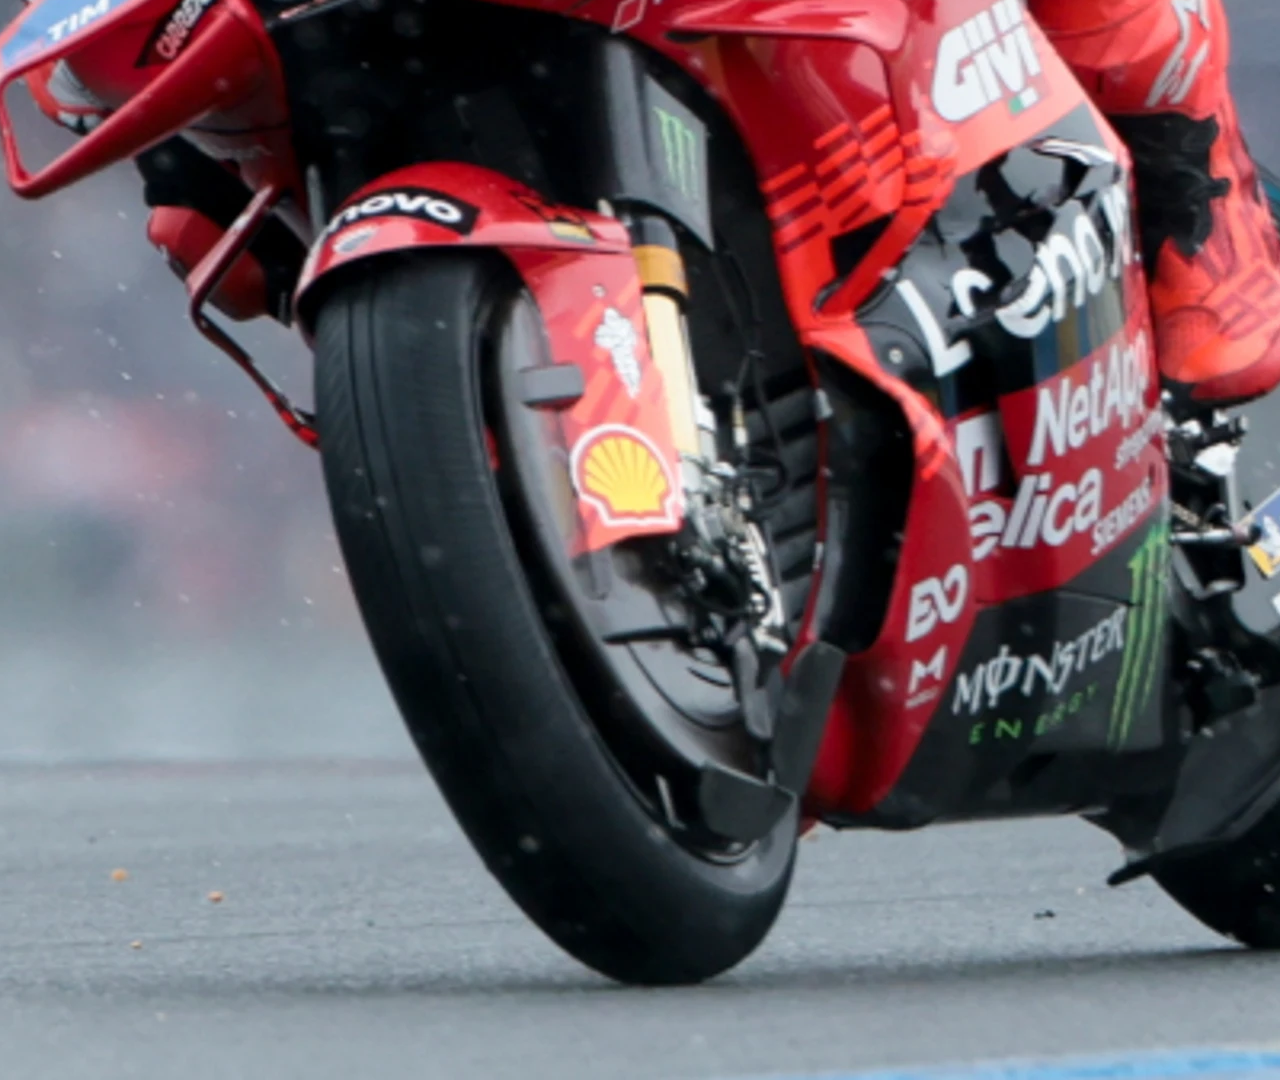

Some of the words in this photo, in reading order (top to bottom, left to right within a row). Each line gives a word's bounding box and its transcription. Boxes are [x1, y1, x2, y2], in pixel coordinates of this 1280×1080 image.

[326, 192, 462, 233] novo
[895, 184, 1132, 379] Lenov
[951, 604, 1128, 716] MONSTER
